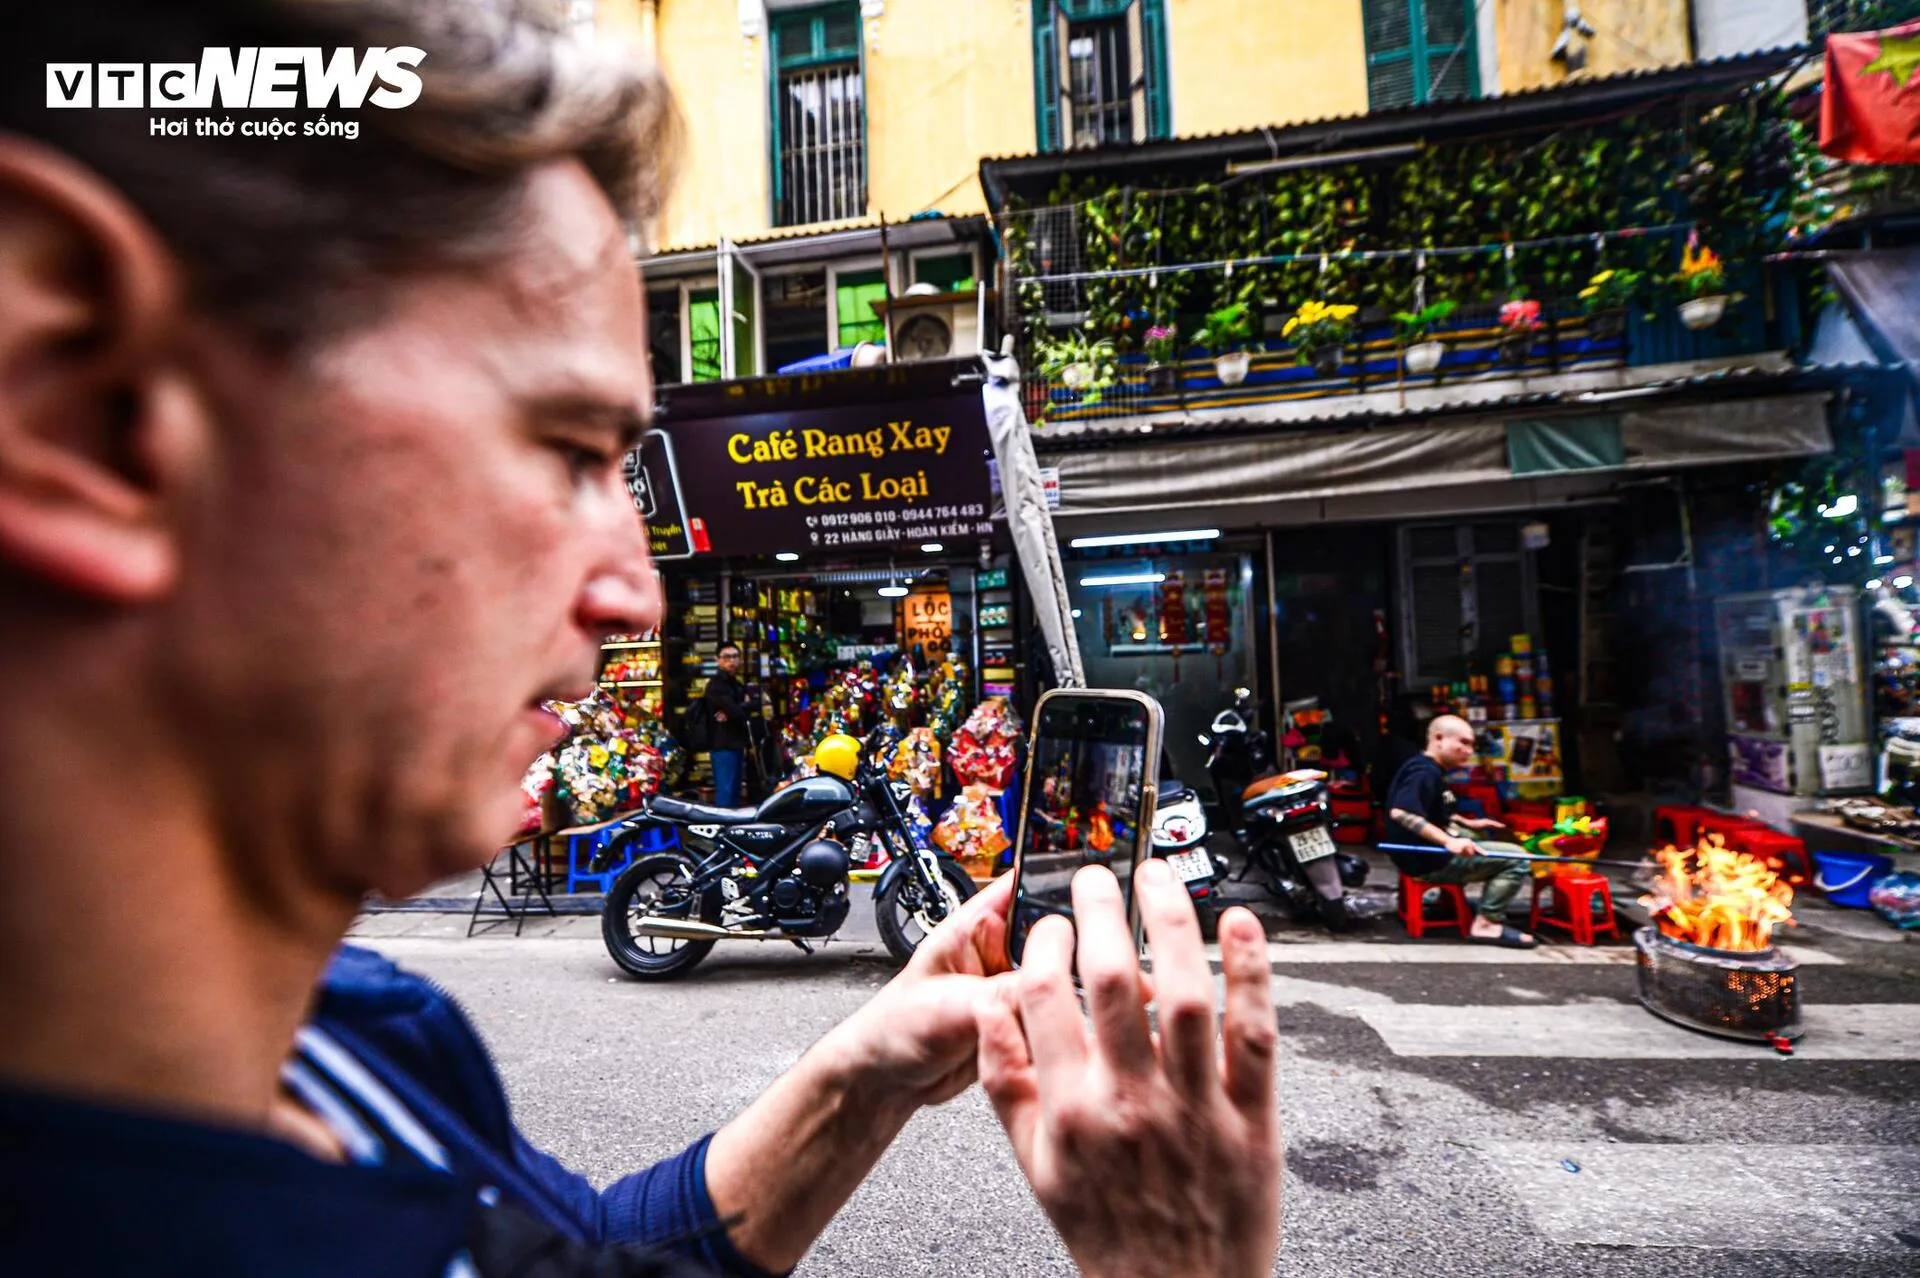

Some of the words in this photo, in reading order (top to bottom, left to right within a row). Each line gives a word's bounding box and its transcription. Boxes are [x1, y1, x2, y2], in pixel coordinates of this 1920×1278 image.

[728, 429, 798, 464] Café
[802, 429, 884, 458] Rang
[888, 421, 951, 455] Xay
[736, 480, 788, 509] Trà
[794, 476, 852, 504] Các
[859, 470, 929, 504] Loại
[821, 513, 849, 527] 0912
[849, 511, 873, 525] 906
[935, 504, 958, 518] 764
[960, 503, 985, 517] 483
[824, 532, 839, 545] 22
